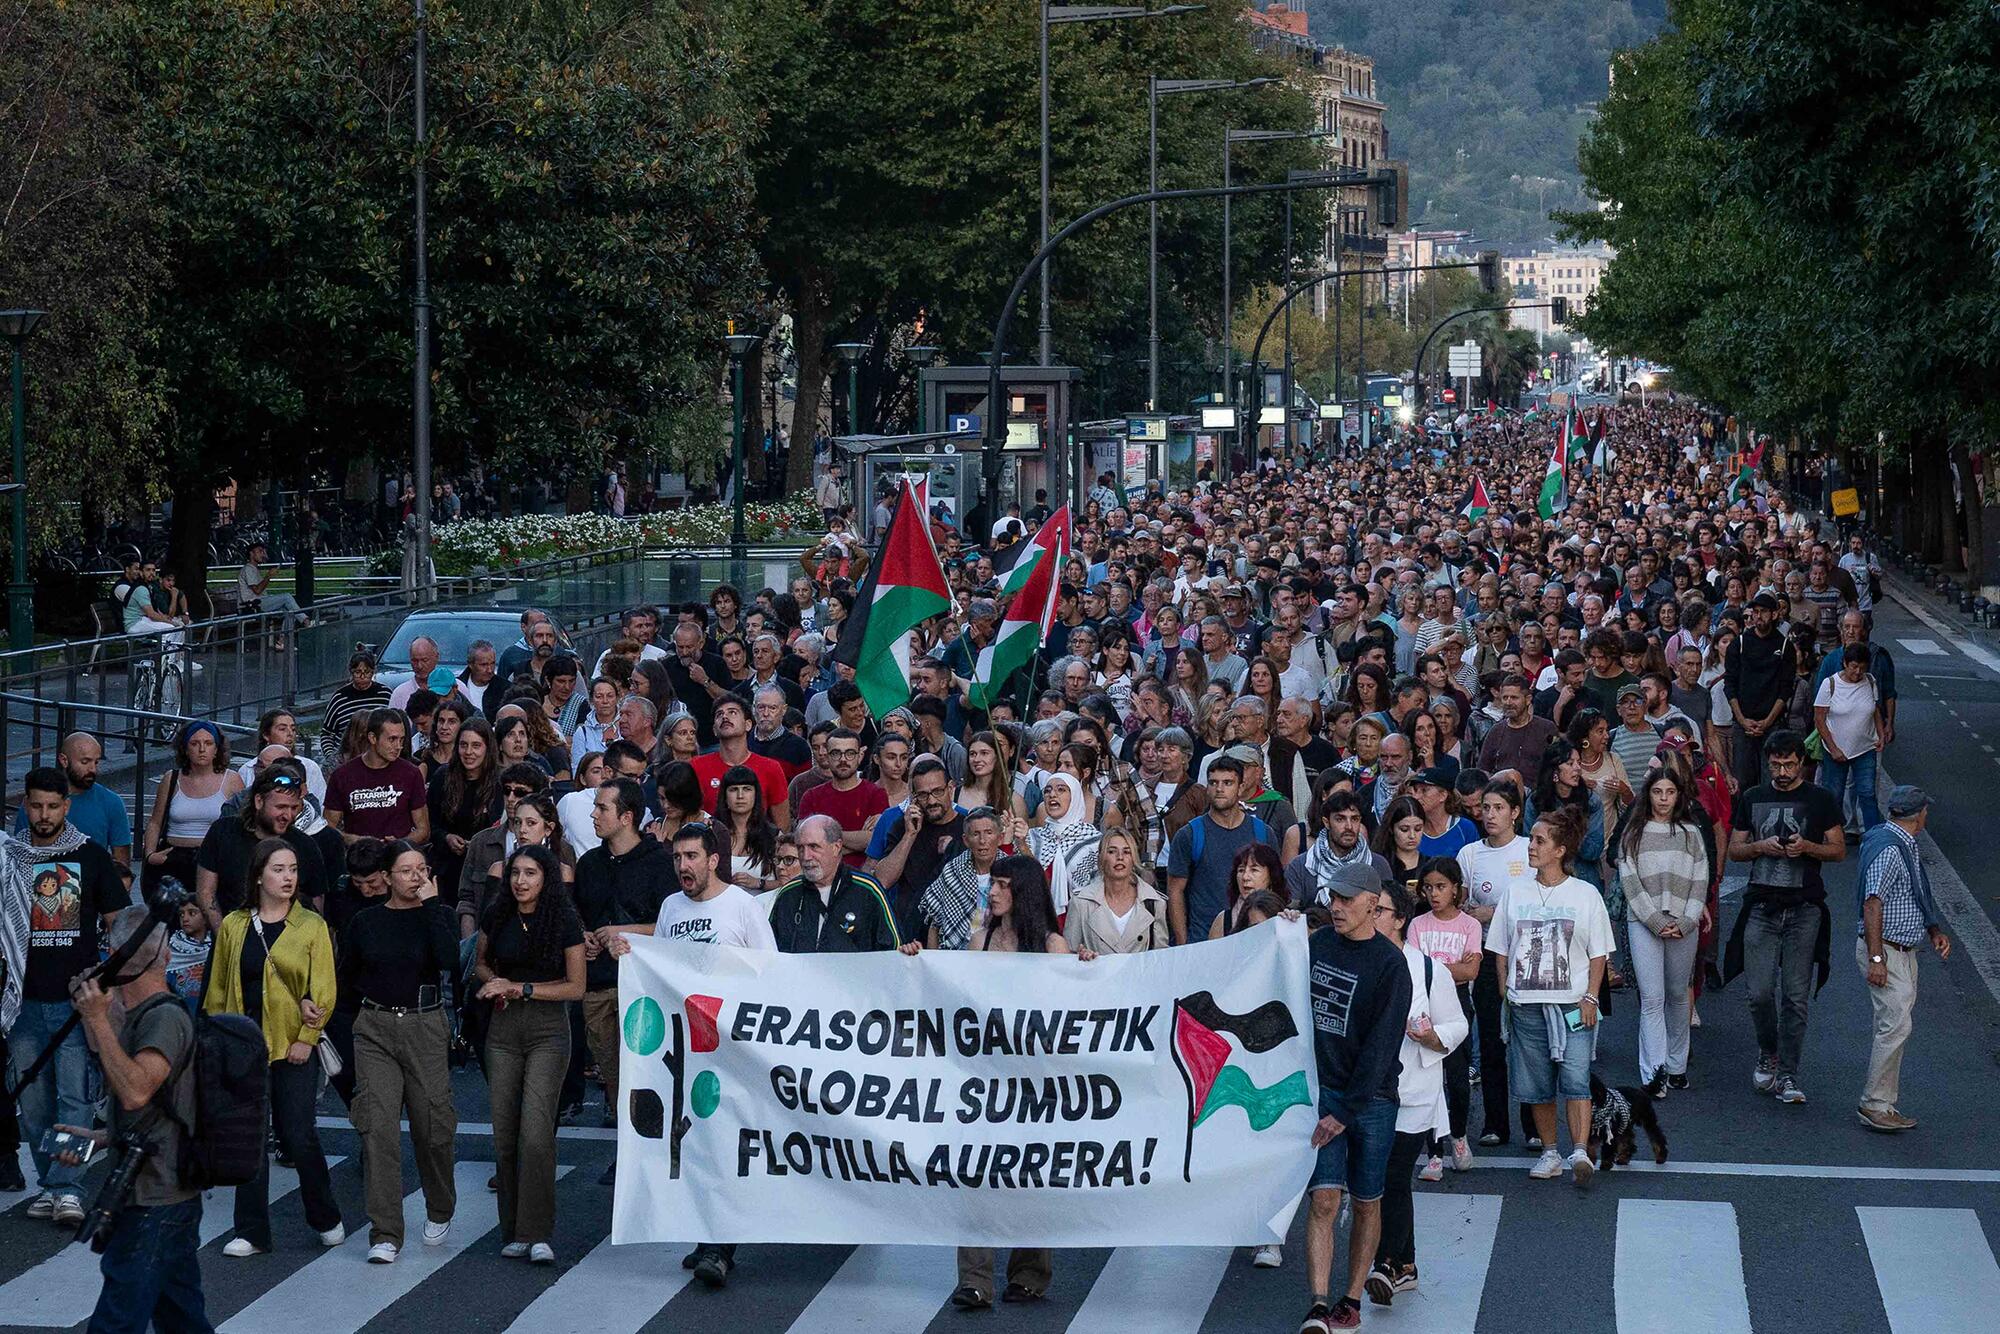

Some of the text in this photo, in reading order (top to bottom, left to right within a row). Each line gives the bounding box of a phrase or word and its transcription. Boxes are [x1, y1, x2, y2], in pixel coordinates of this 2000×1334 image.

[957, 418, 970, 432] P
[32, 937, 73, 947] DESDE 1948
[1328, 991, 1339, 1001] ez
[1314, 1000, 1329, 1012] da
[731, 1002, 1160, 1057] ERASOEN GAINETIK
[770, 1065, 1122, 1124] GLOBAL SUMUD
[737, 1127, 1158, 1189] FLOTILLA AURRERA!
